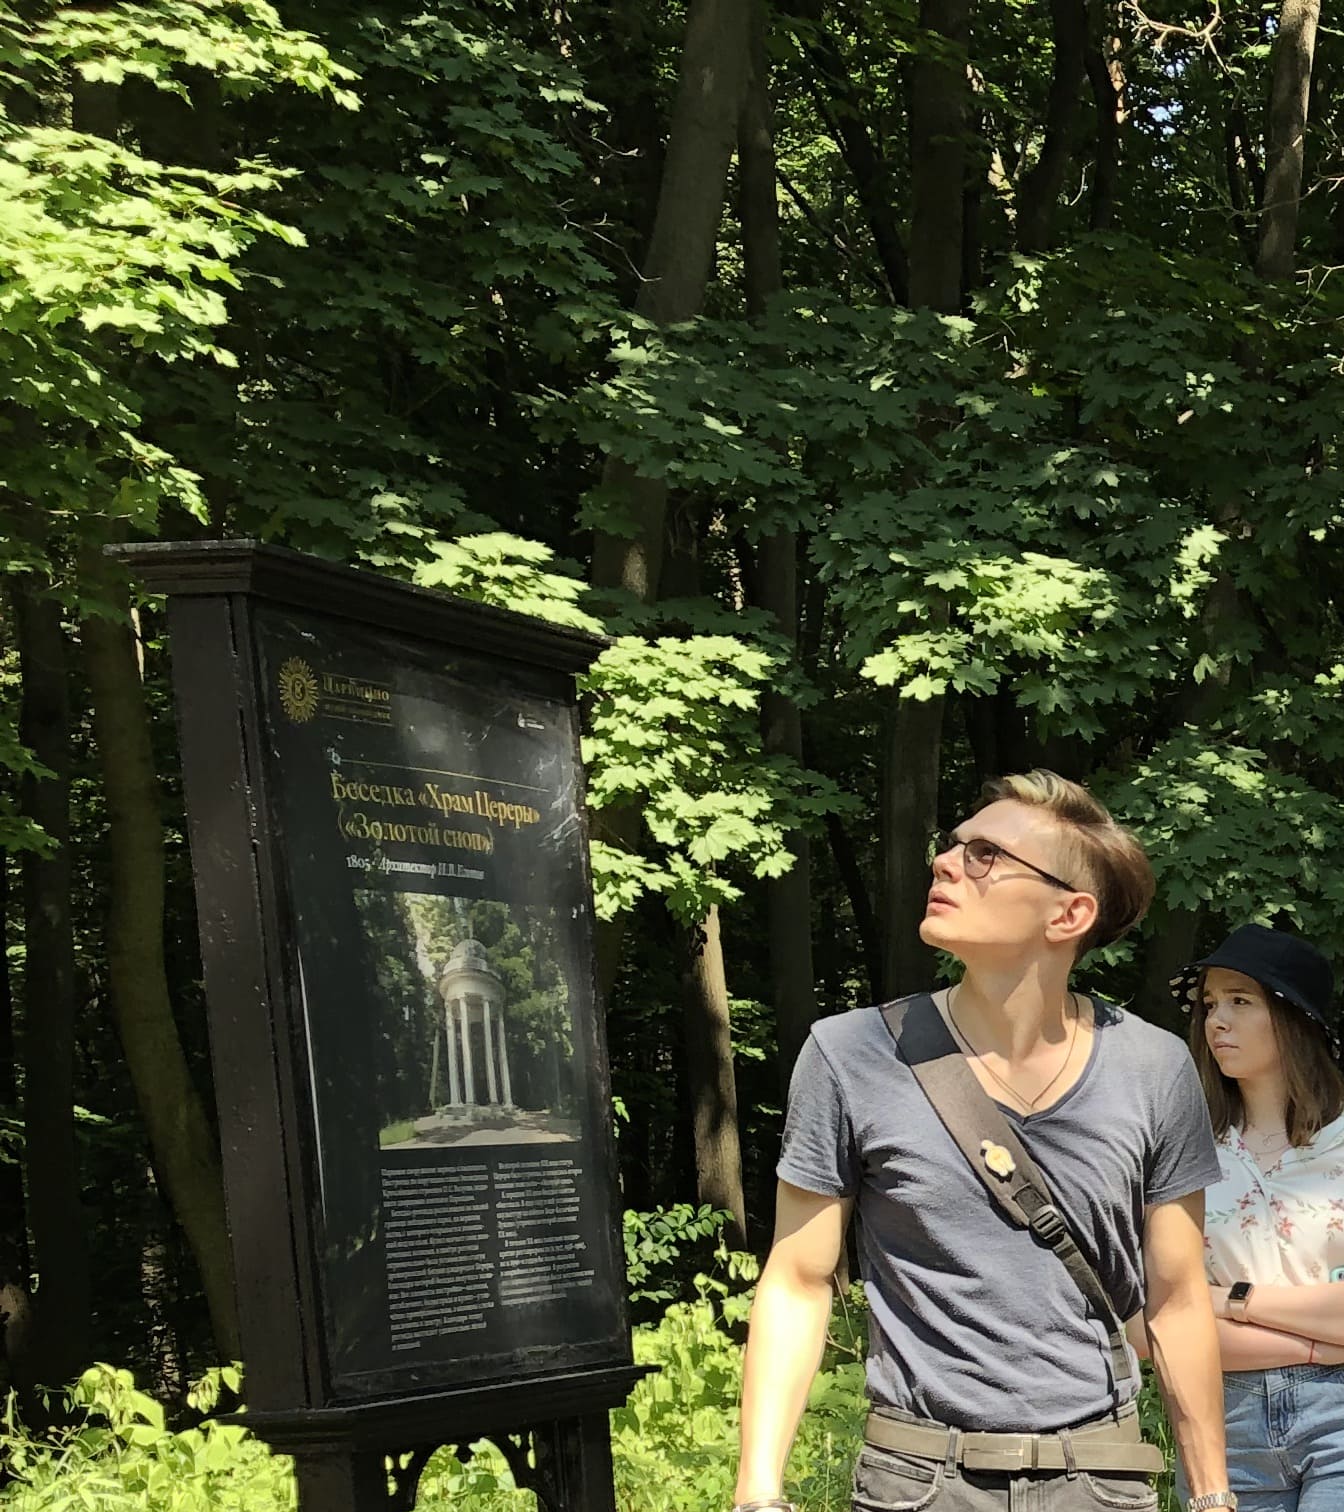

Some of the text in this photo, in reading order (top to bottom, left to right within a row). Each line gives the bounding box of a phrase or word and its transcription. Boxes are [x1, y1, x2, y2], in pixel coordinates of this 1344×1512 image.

[331, 770, 541, 829] Беседка «Храм Цереры»
[338, 807, 495, 856] («Золотой сноп»)
